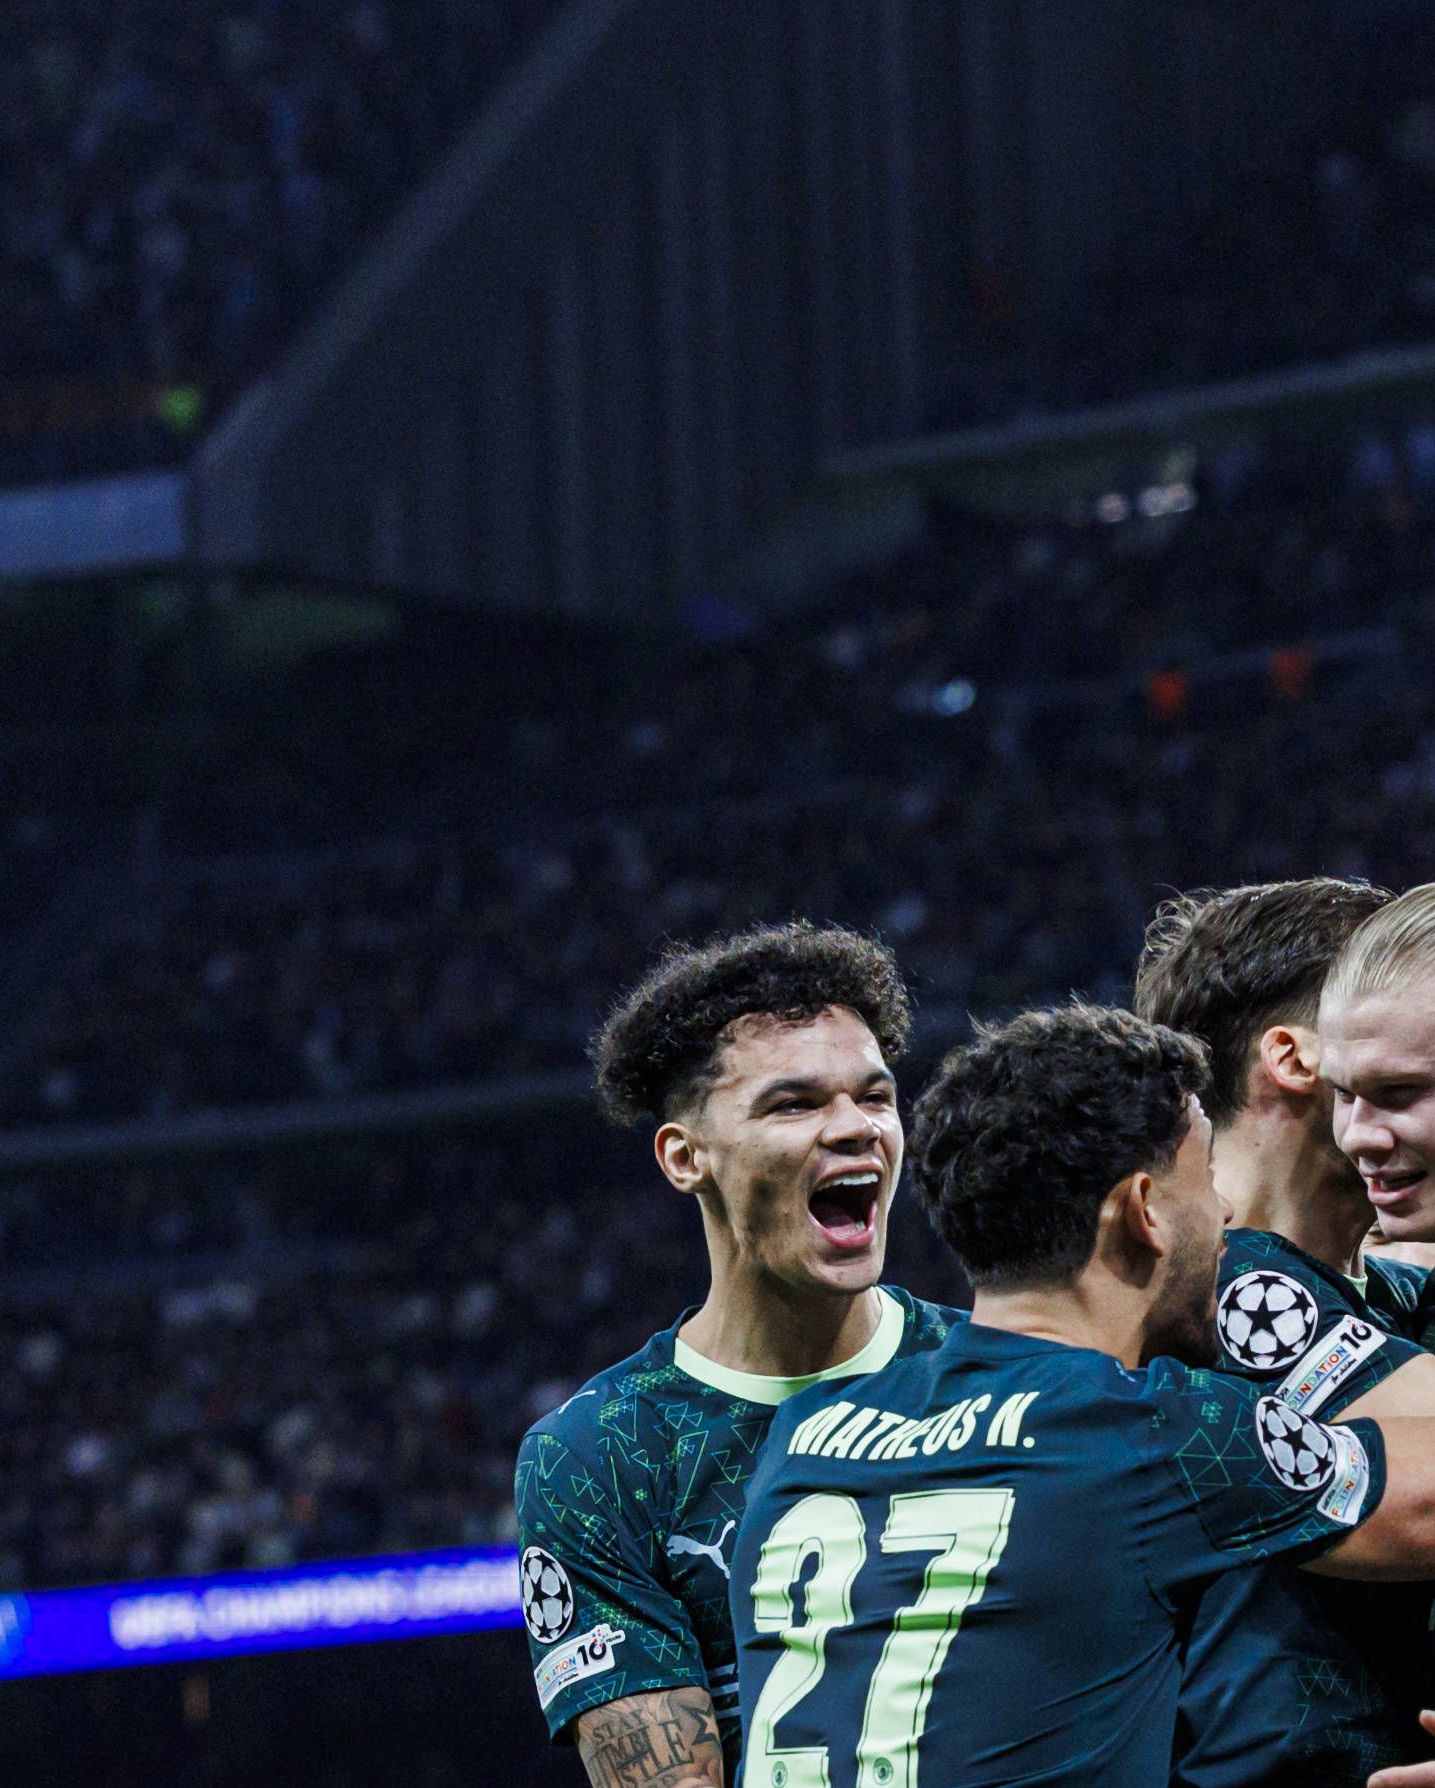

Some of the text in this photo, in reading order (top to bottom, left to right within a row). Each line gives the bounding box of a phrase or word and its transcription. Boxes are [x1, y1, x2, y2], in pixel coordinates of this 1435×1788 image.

[1287, 1346, 1347, 1409] OUNDATION
[787, 1391, 1040, 1460] MATHEUS N.
